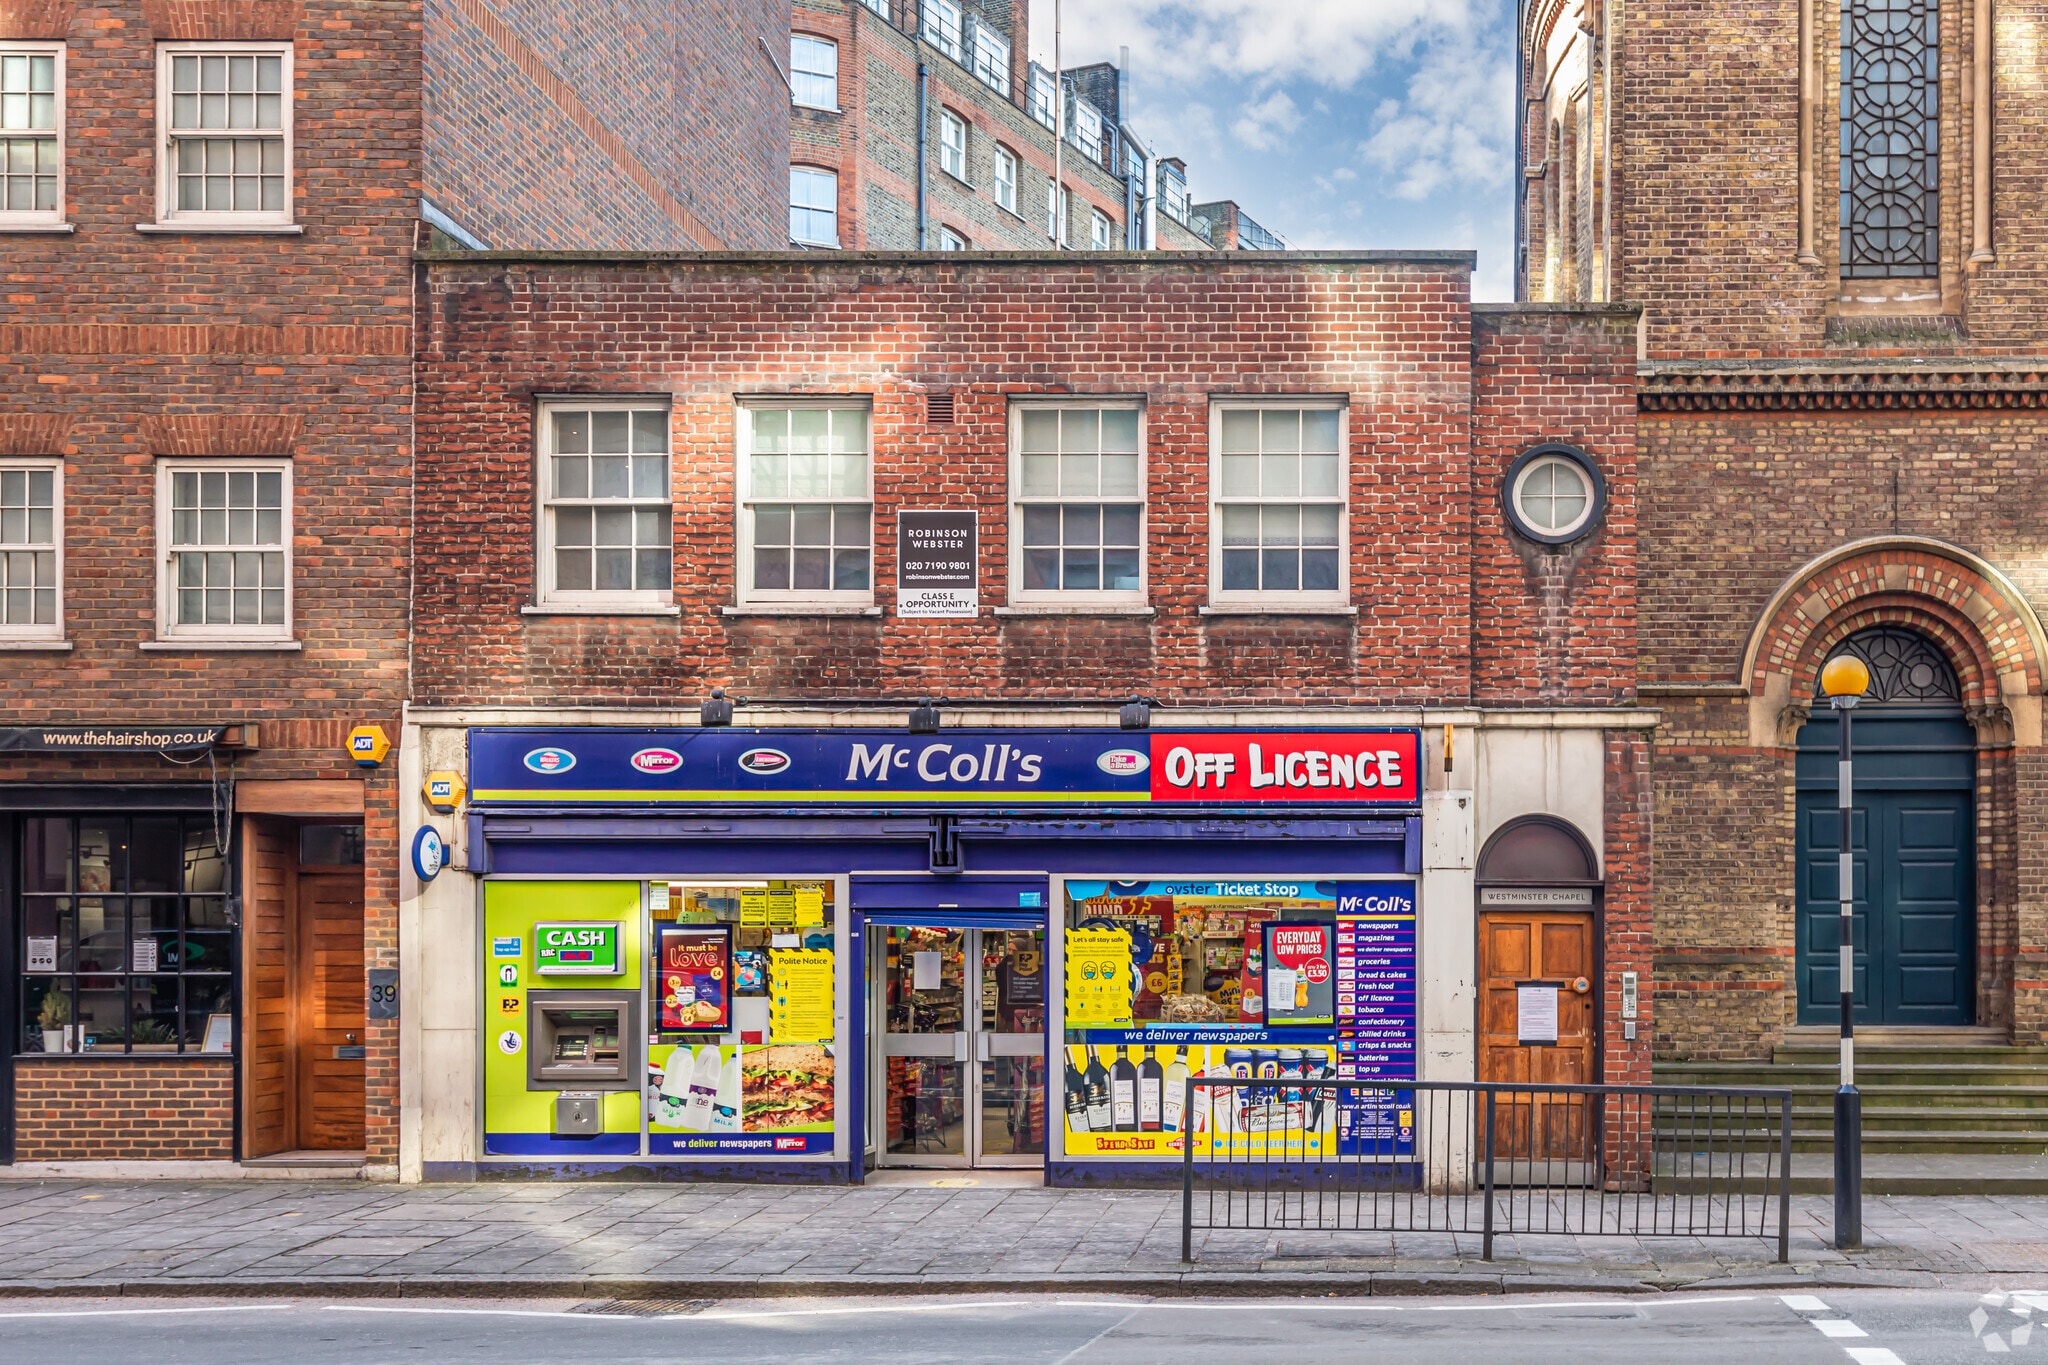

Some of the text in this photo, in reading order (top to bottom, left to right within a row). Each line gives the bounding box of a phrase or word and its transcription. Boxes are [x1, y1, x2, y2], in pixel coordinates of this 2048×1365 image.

[908, 529, 968, 538] ROBINSON
[912, 540, 964, 548] WEBSTER
[905, 561, 970, 570] 020 7190 9801
[921, 592, 955, 600] CLASS E
[905, 600, 970, 608] OPPORTUNITY
[43, 729, 216, 748] www.thehairshop.co.uk
[354, 737, 373, 749] ADT
[640, 754, 675, 767] Mirror
[431, 782, 450, 794] ADT
[1165, 882, 1299, 897] oyster Ticket Stop
[1358, 923, 1399, 931] newspapers
[546, 930, 607, 946] CASH
[1097, 936, 1110, 944] stay
[1276, 930, 1321, 944] EVERYDAY
[1358, 935, 1395, 943] magazines
[678, 944, 685, 952] It
[707, 944, 718, 952] be
[1277, 944, 1322, 955] LOW PRICES
[670, 947, 718, 967] love
[778, 957, 828, 965] Polite Notice
[1358, 958, 1391, 966] groceries
[1307, 969, 1327, 978] £3.50
[1358, 971, 1407, 979] bread & cakes
[1151, 978, 1163, 987] £6
[1358, 982, 1377, 990] fresh
[1378, 982, 1395, 990] food
[371, 984, 396, 1003] 39
[1358, 1018, 1405, 1026] confectionery
[1124, 1030, 1268, 1042] we deliver newspapers
[1358, 1041, 1379, 1049] crisps
[1387, 1041, 1412, 1049] snacks
[713, 1118, 734, 1127] MILK
[672, 1138, 804, 1150] we deliver newspapers Mirror
